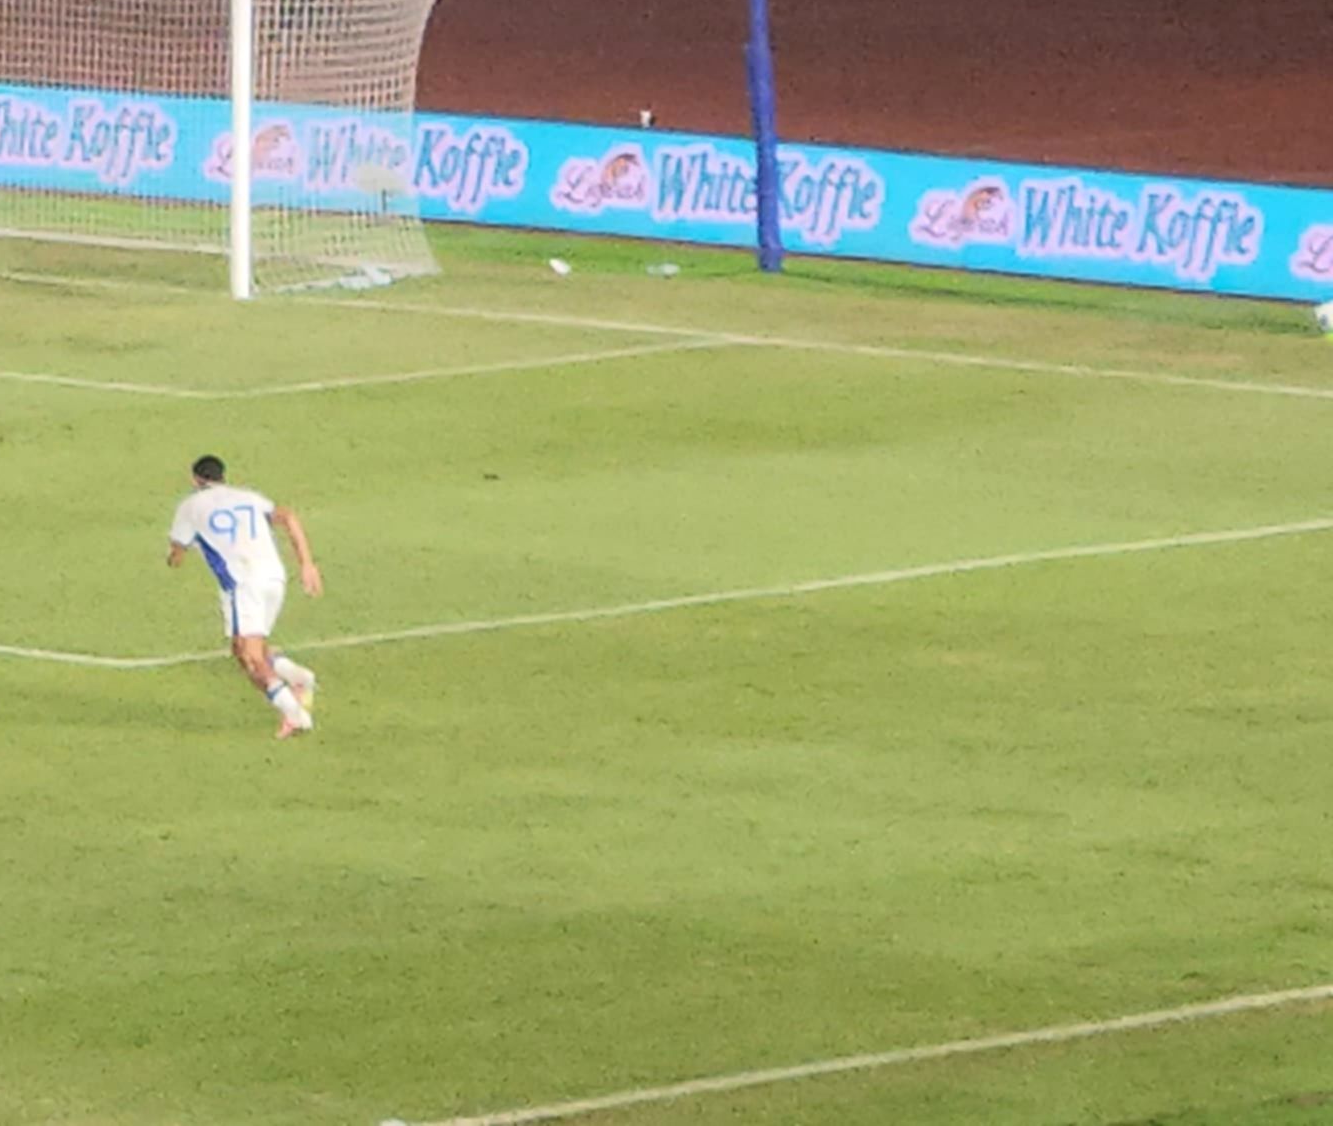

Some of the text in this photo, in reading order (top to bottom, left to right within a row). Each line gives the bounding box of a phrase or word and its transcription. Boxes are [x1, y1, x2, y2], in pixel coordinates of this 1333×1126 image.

[64, 102, 171, 178] Koffie
[414, 127, 522, 204] Koffie
[657, 151, 758, 214] White
[1023, 184, 1128, 249] White
[1136, 192, 1255, 273] Koffie
[208, 504, 257, 543] 97
